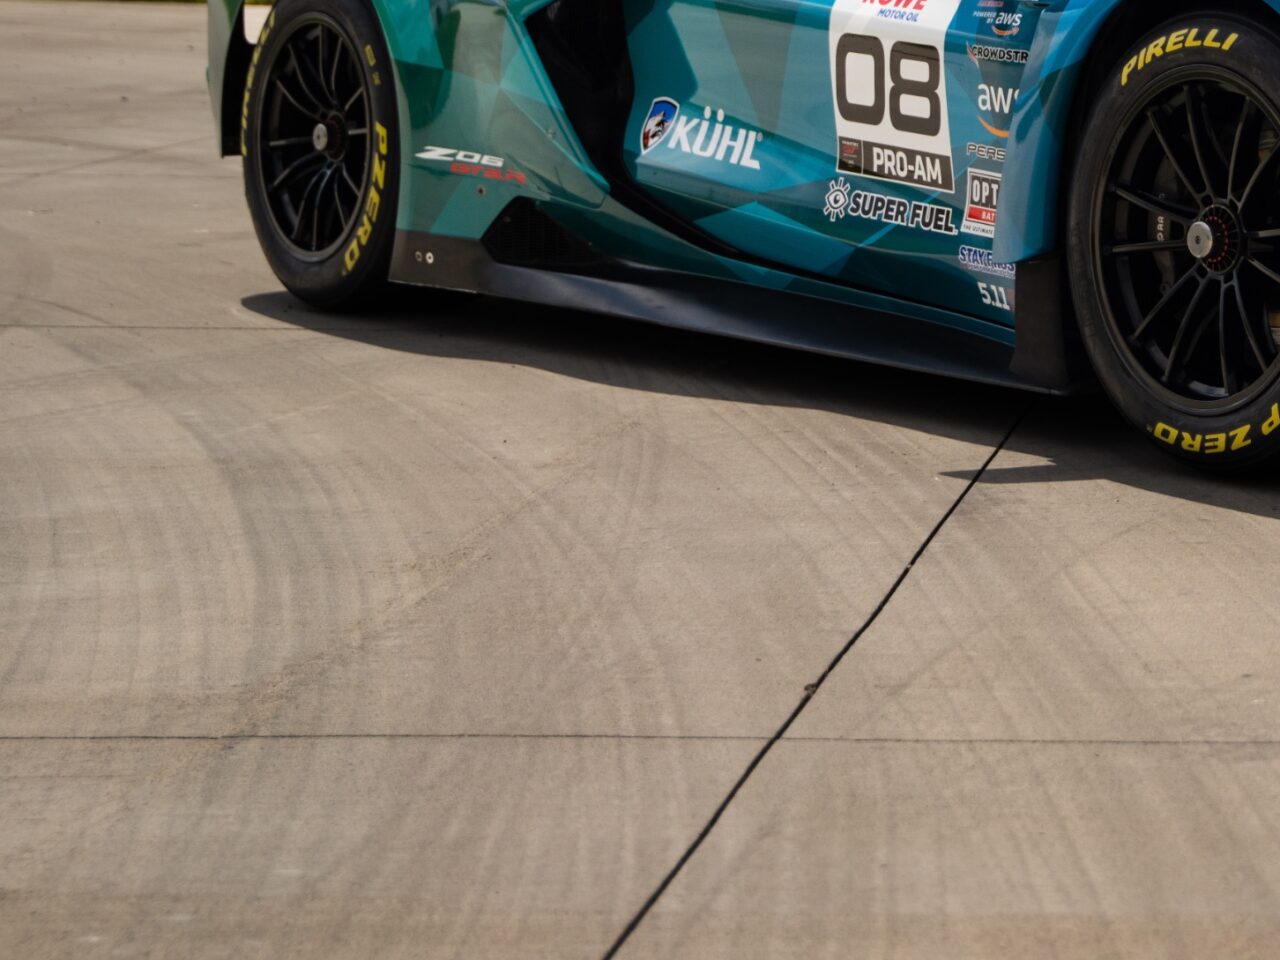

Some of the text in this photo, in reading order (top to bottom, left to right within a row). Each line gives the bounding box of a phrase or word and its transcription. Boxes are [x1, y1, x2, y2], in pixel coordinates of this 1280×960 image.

[877, 8, 919, 23] MOTOR OIL
[995, 12, 1023, 26] aws
[1121, 27, 1239, 86] PIRELLI
[835, 32, 941, 137] 08
[977, 82, 1019, 115] aw
[414, 145, 505, 168] Z06
[667, 105, 762, 170] KÜHL
[872, 146, 943, 185] PRO-AM
[343, 120, 389, 273] P ZERO
[848, 190, 908, 227] SUPER
[977, 281, 1011, 311] 5.11
[1153, 402, 1280, 454] P ZERO
